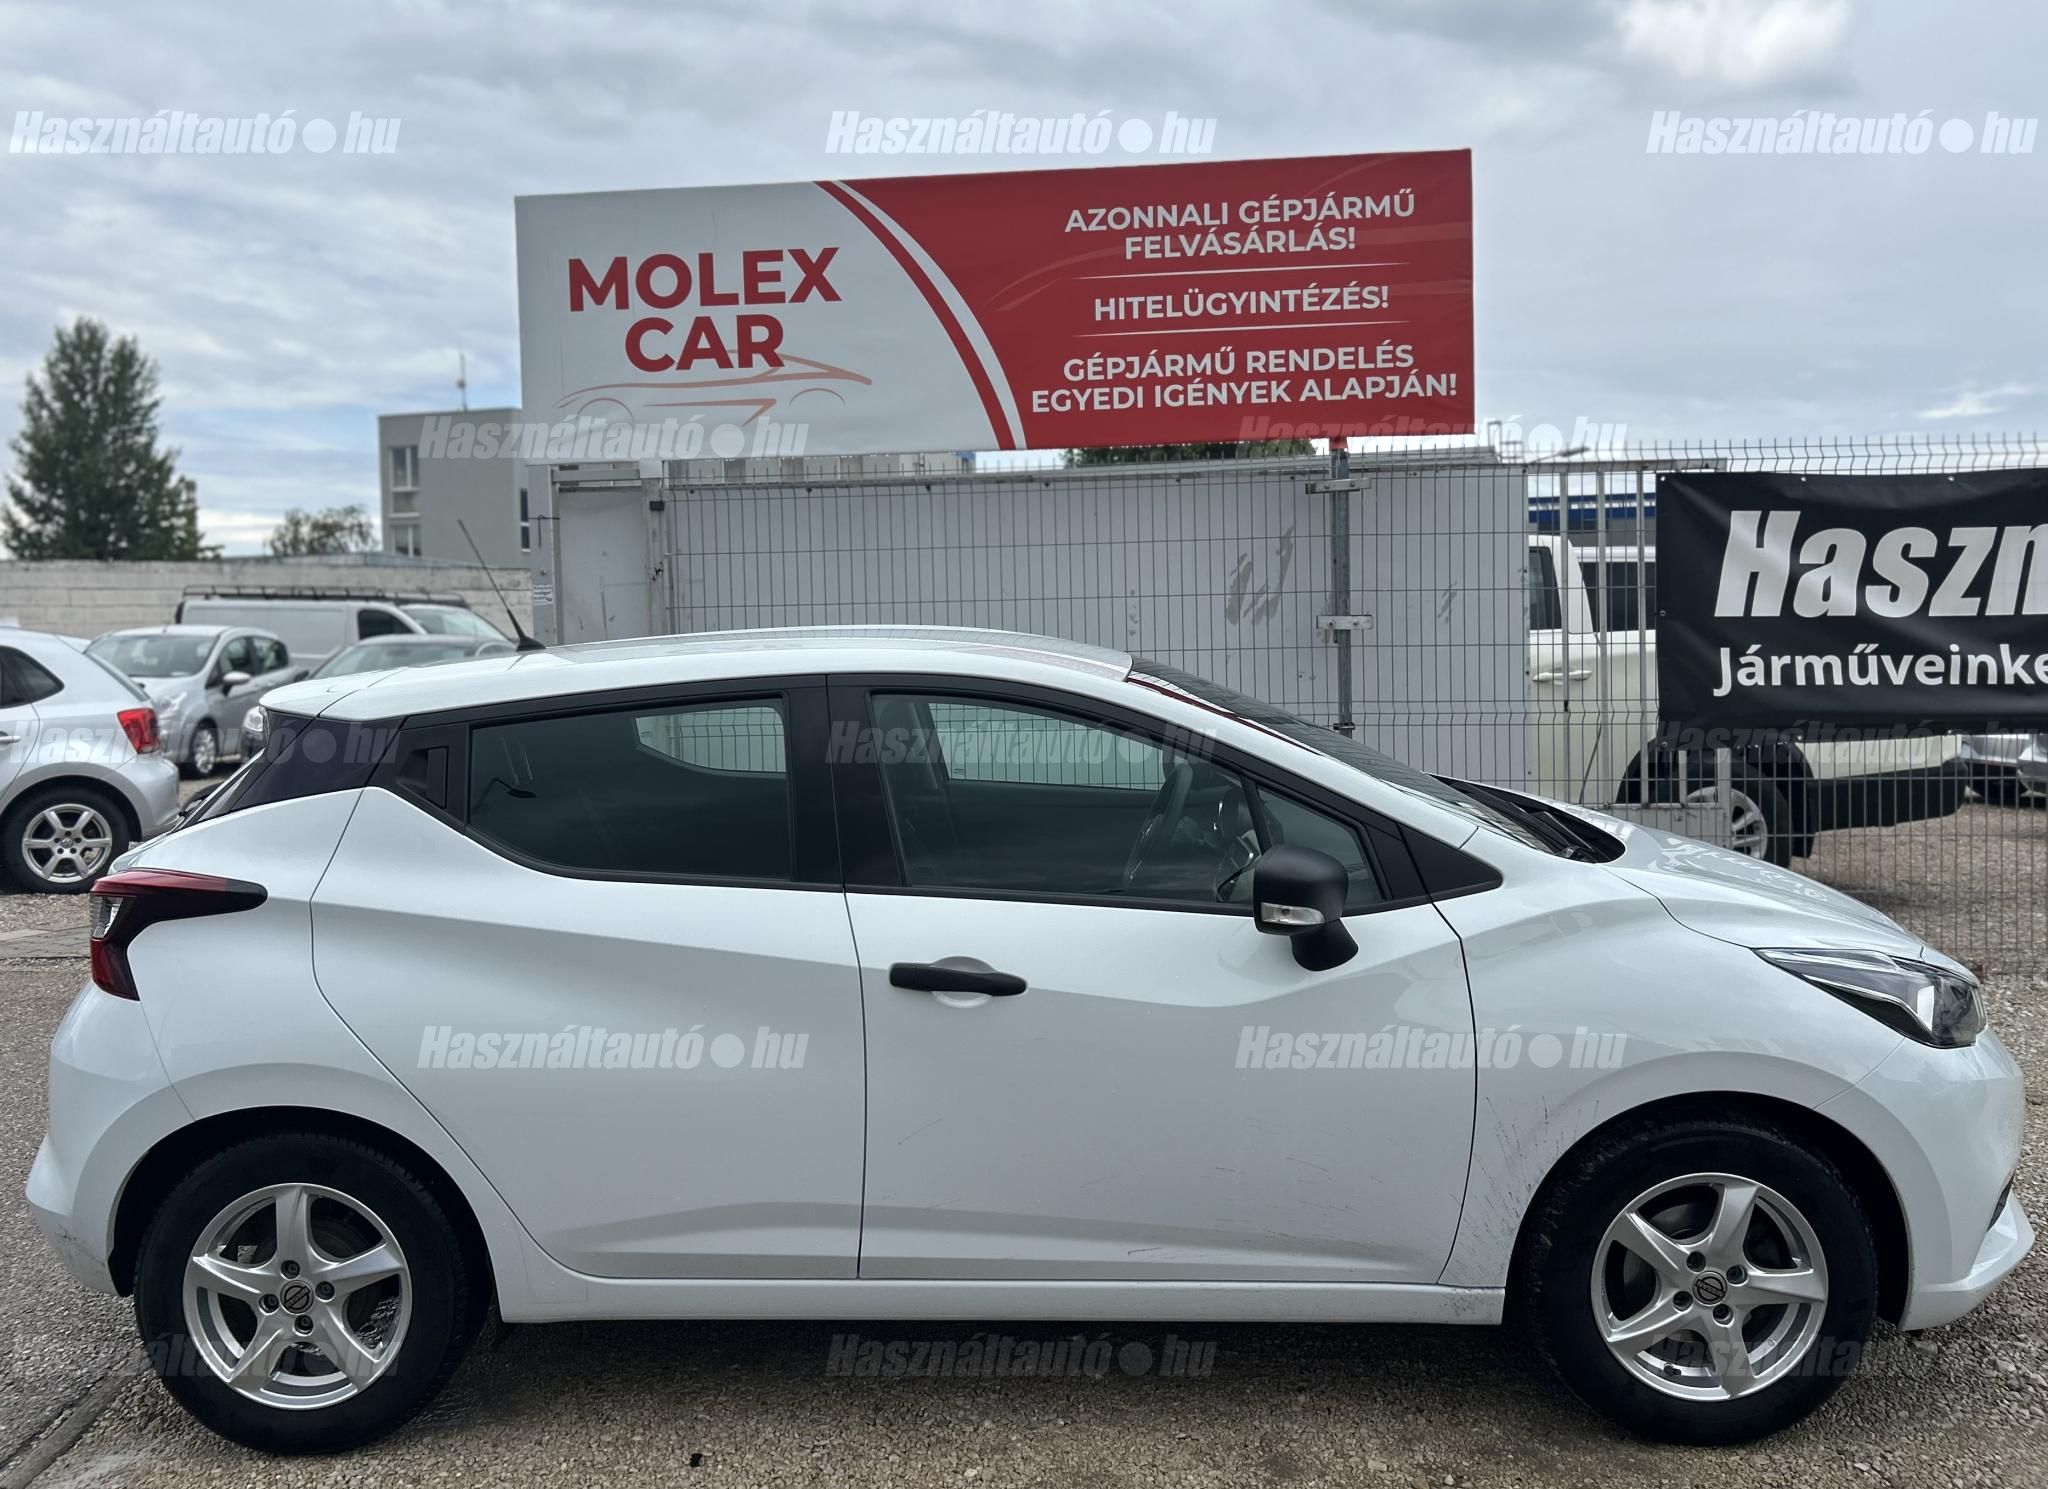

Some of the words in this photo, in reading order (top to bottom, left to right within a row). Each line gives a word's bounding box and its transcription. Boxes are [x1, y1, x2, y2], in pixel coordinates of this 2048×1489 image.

[1065, 202, 1228, 233] AZONNALI
[1239, 189, 1415, 224] GÉPJÁRMŰ
[1126, 223, 1355, 260] FELVÁSÁRLÁS!
[568, 247, 842, 312] MOLEX
[1095, 282, 1389, 321] HITELÜGYINTÉZÉS!
[625, 314, 784, 373] CAR
[1063, 346, 1235, 382] GÉPJÁRMŰ
[1247, 339, 1414, 374] RENDELÉS
[1033, 386, 1145, 413] EGYEDI
[1154, 377, 1291, 410] IGÉNYEK
[1299, 368, 1457, 404] ALAPJÁN!
